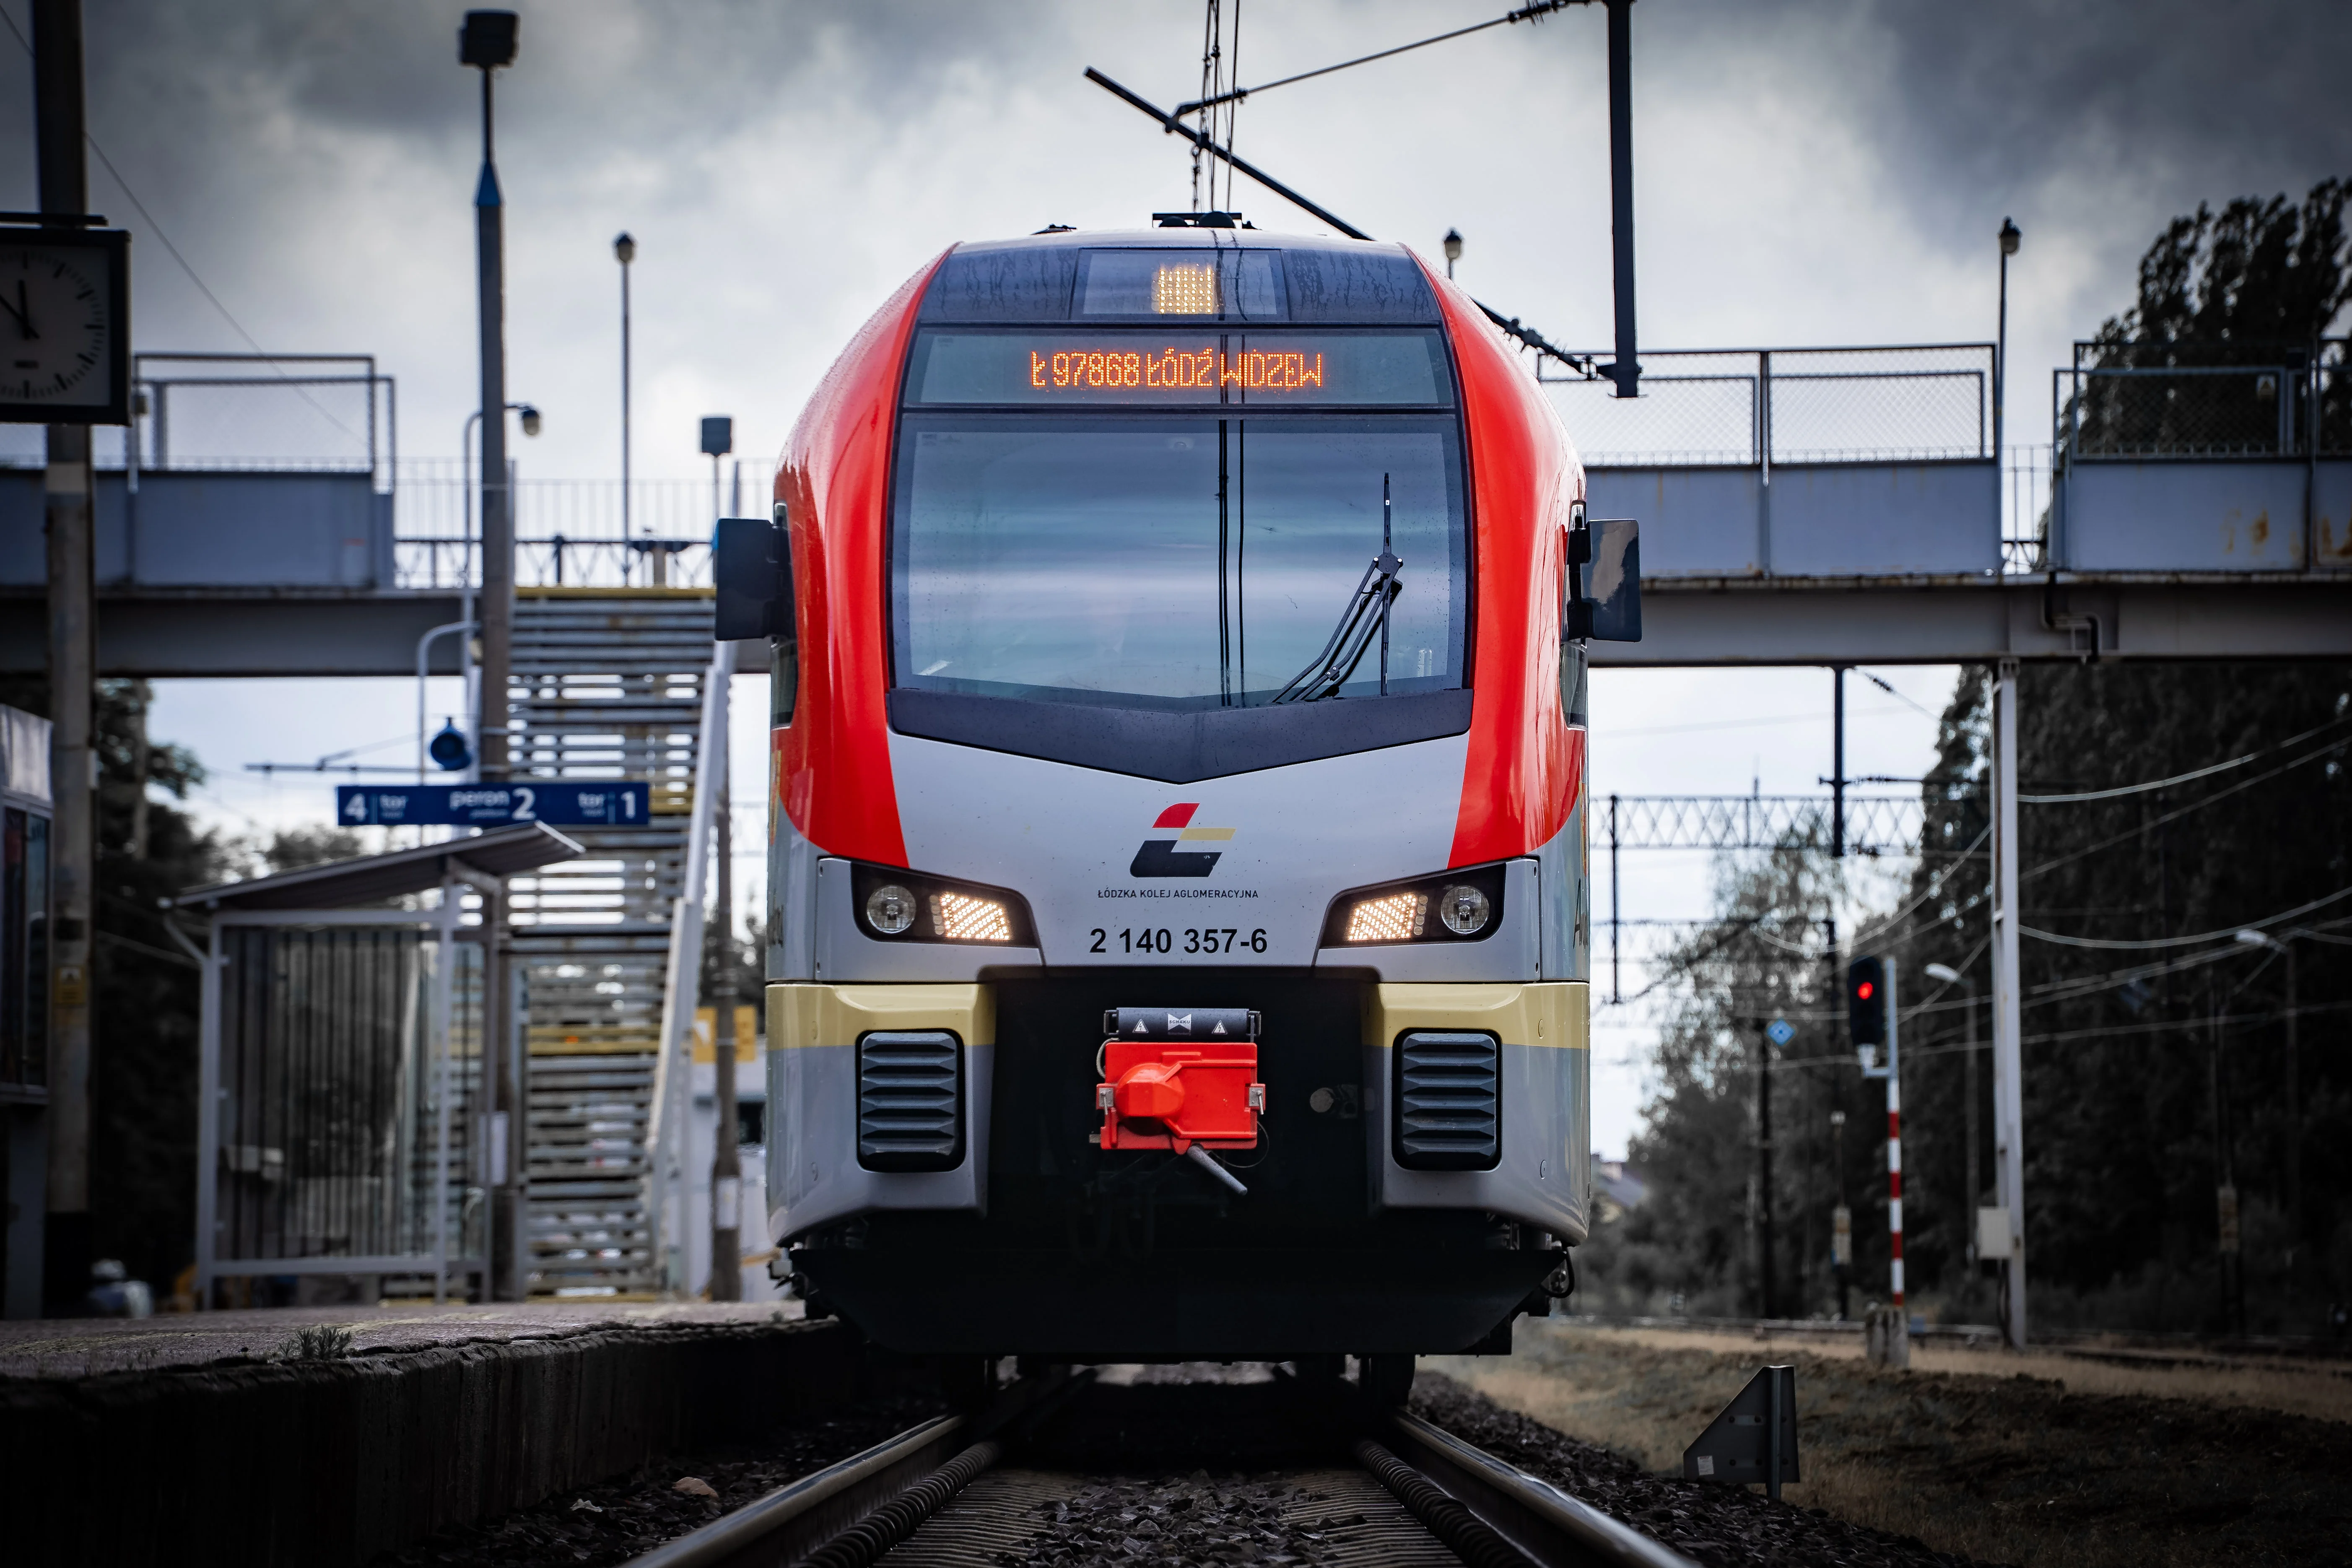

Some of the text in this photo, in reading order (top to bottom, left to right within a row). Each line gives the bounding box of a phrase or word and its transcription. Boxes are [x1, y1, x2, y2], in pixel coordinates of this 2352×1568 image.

[1052, 352, 1141, 387] 97868
[1147, 348, 1213, 387] ŁÓDŹ
[1220, 351, 1322, 387] WIDZEW
[345, 793, 369, 822] 4
[511, 787, 537, 820] 2
[620, 791, 636, 819] 1
[1098, 886, 1258, 898] ŁÓDZKA KOLEJ AGLOMERACYJNA
[1090, 928, 1267, 954] 2 140 357-6
